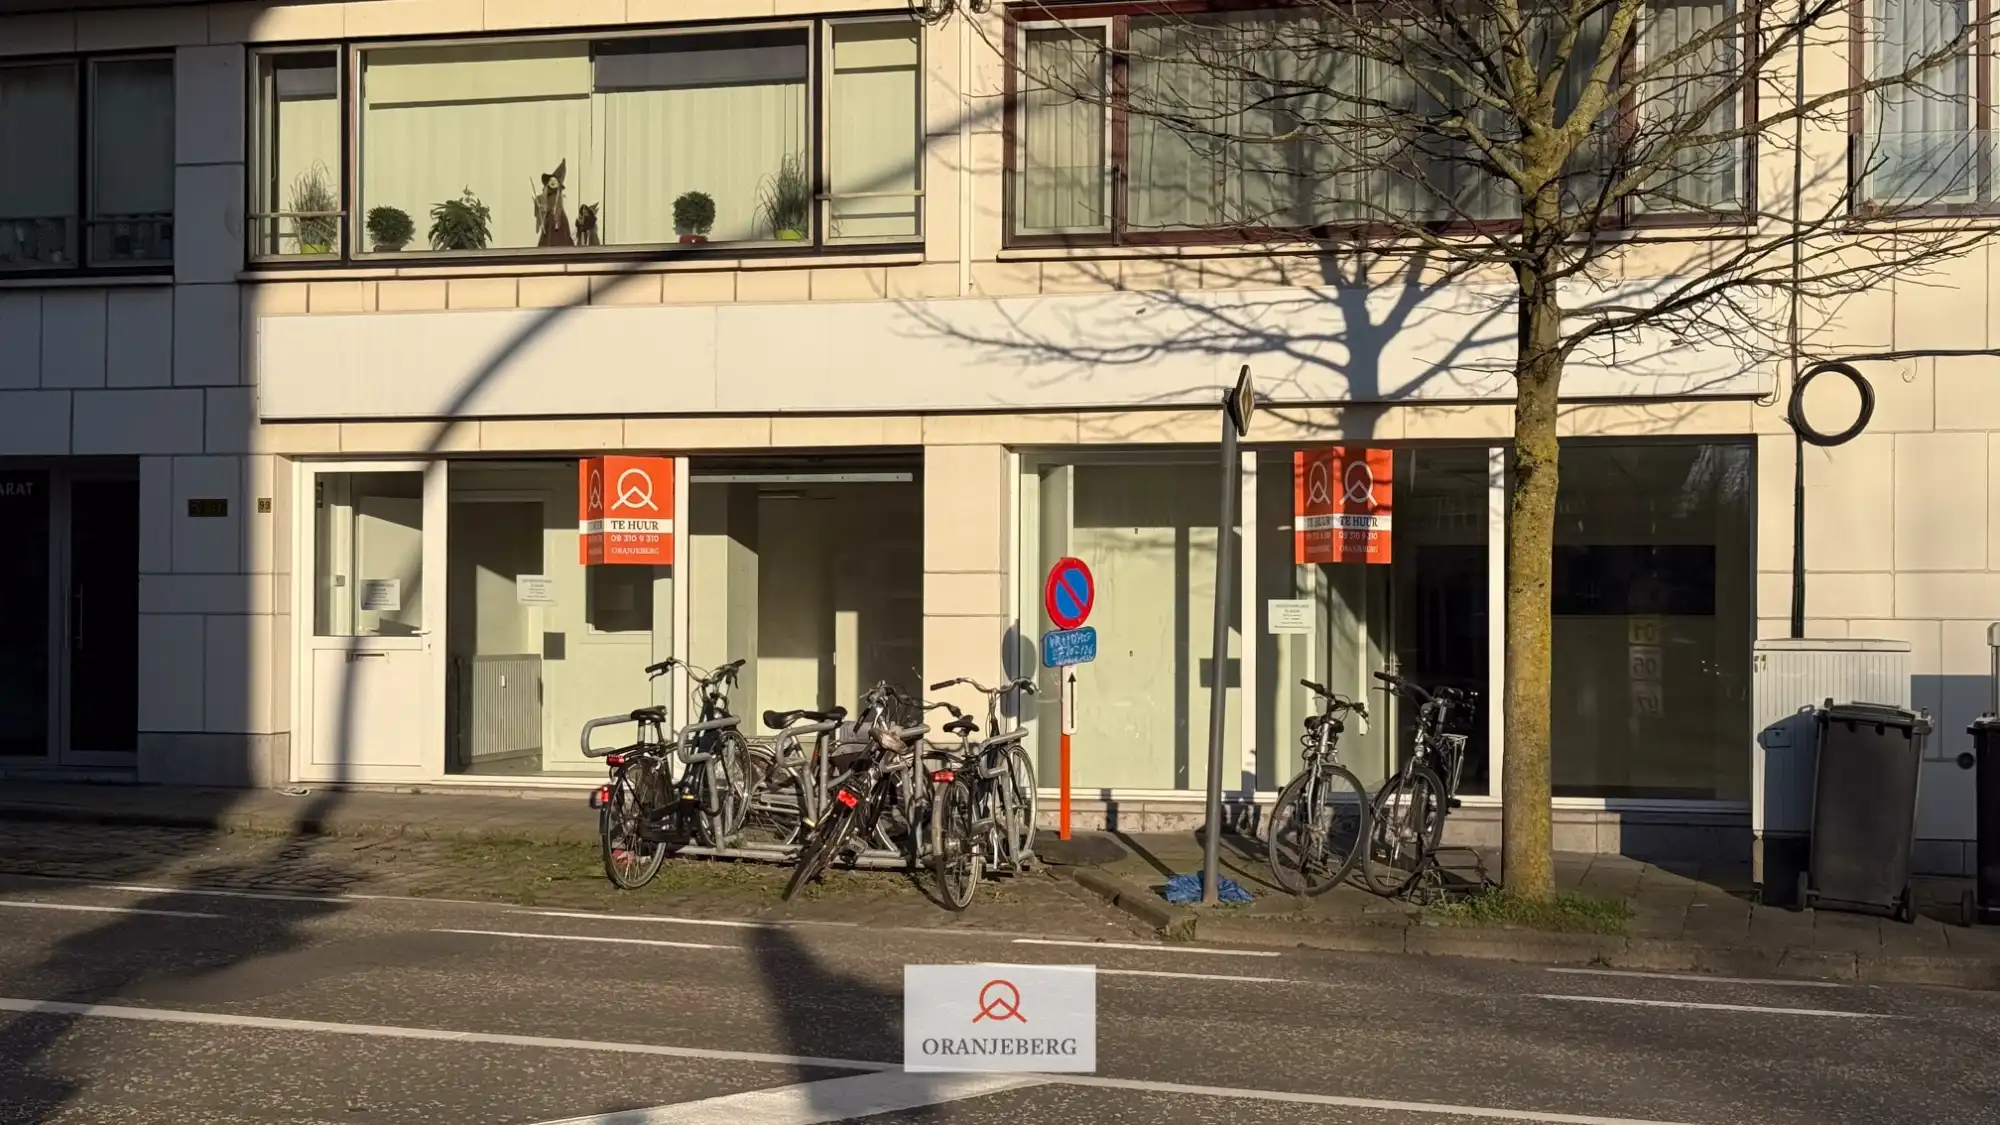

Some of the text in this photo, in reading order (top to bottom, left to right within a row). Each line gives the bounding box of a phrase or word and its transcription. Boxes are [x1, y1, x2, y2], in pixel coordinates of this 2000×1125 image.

[259, 501, 271, 510] 99
[611, 520, 625, 530] TE
[628, 520, 660, 531] HUUR
[1339, 516, 1378, 528] TE HUUR
